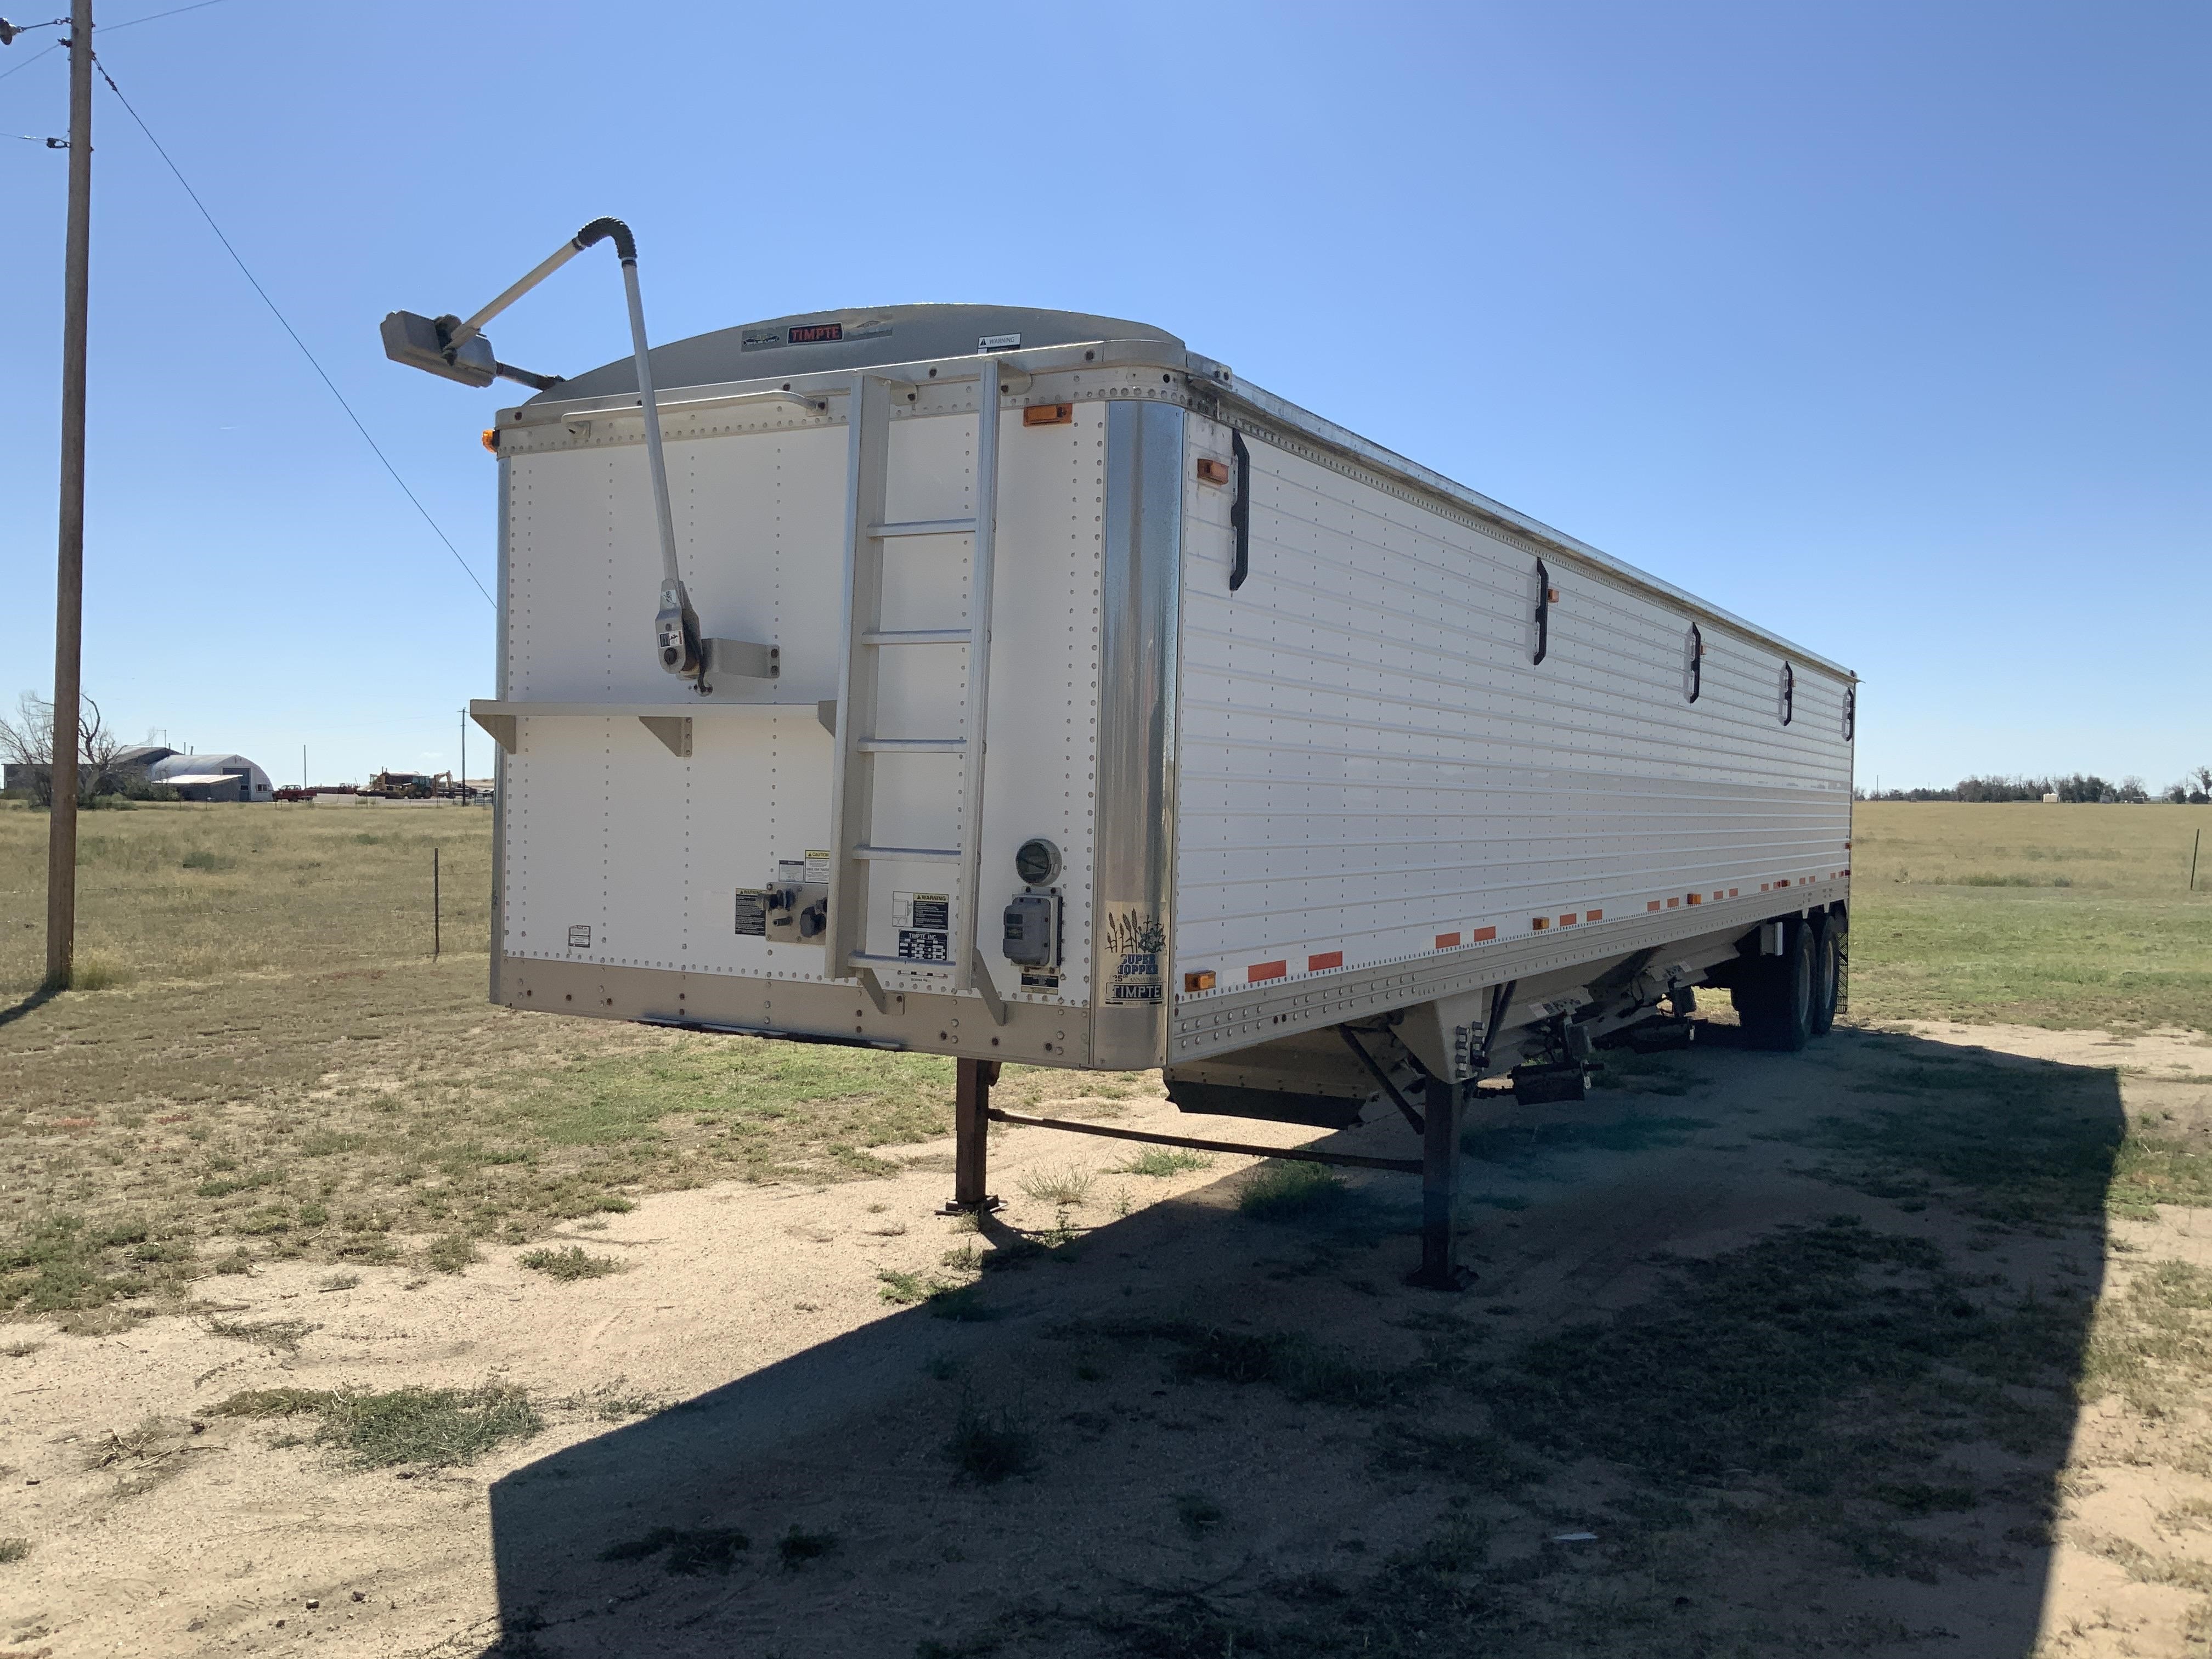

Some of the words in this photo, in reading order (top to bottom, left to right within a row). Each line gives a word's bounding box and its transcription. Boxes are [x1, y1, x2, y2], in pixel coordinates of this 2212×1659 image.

[792, 325, 839, 341] TIMPTE
[1120, 954, 1155, 964] SUPER
[1113, 985, 1160, 998] TIMPTE
